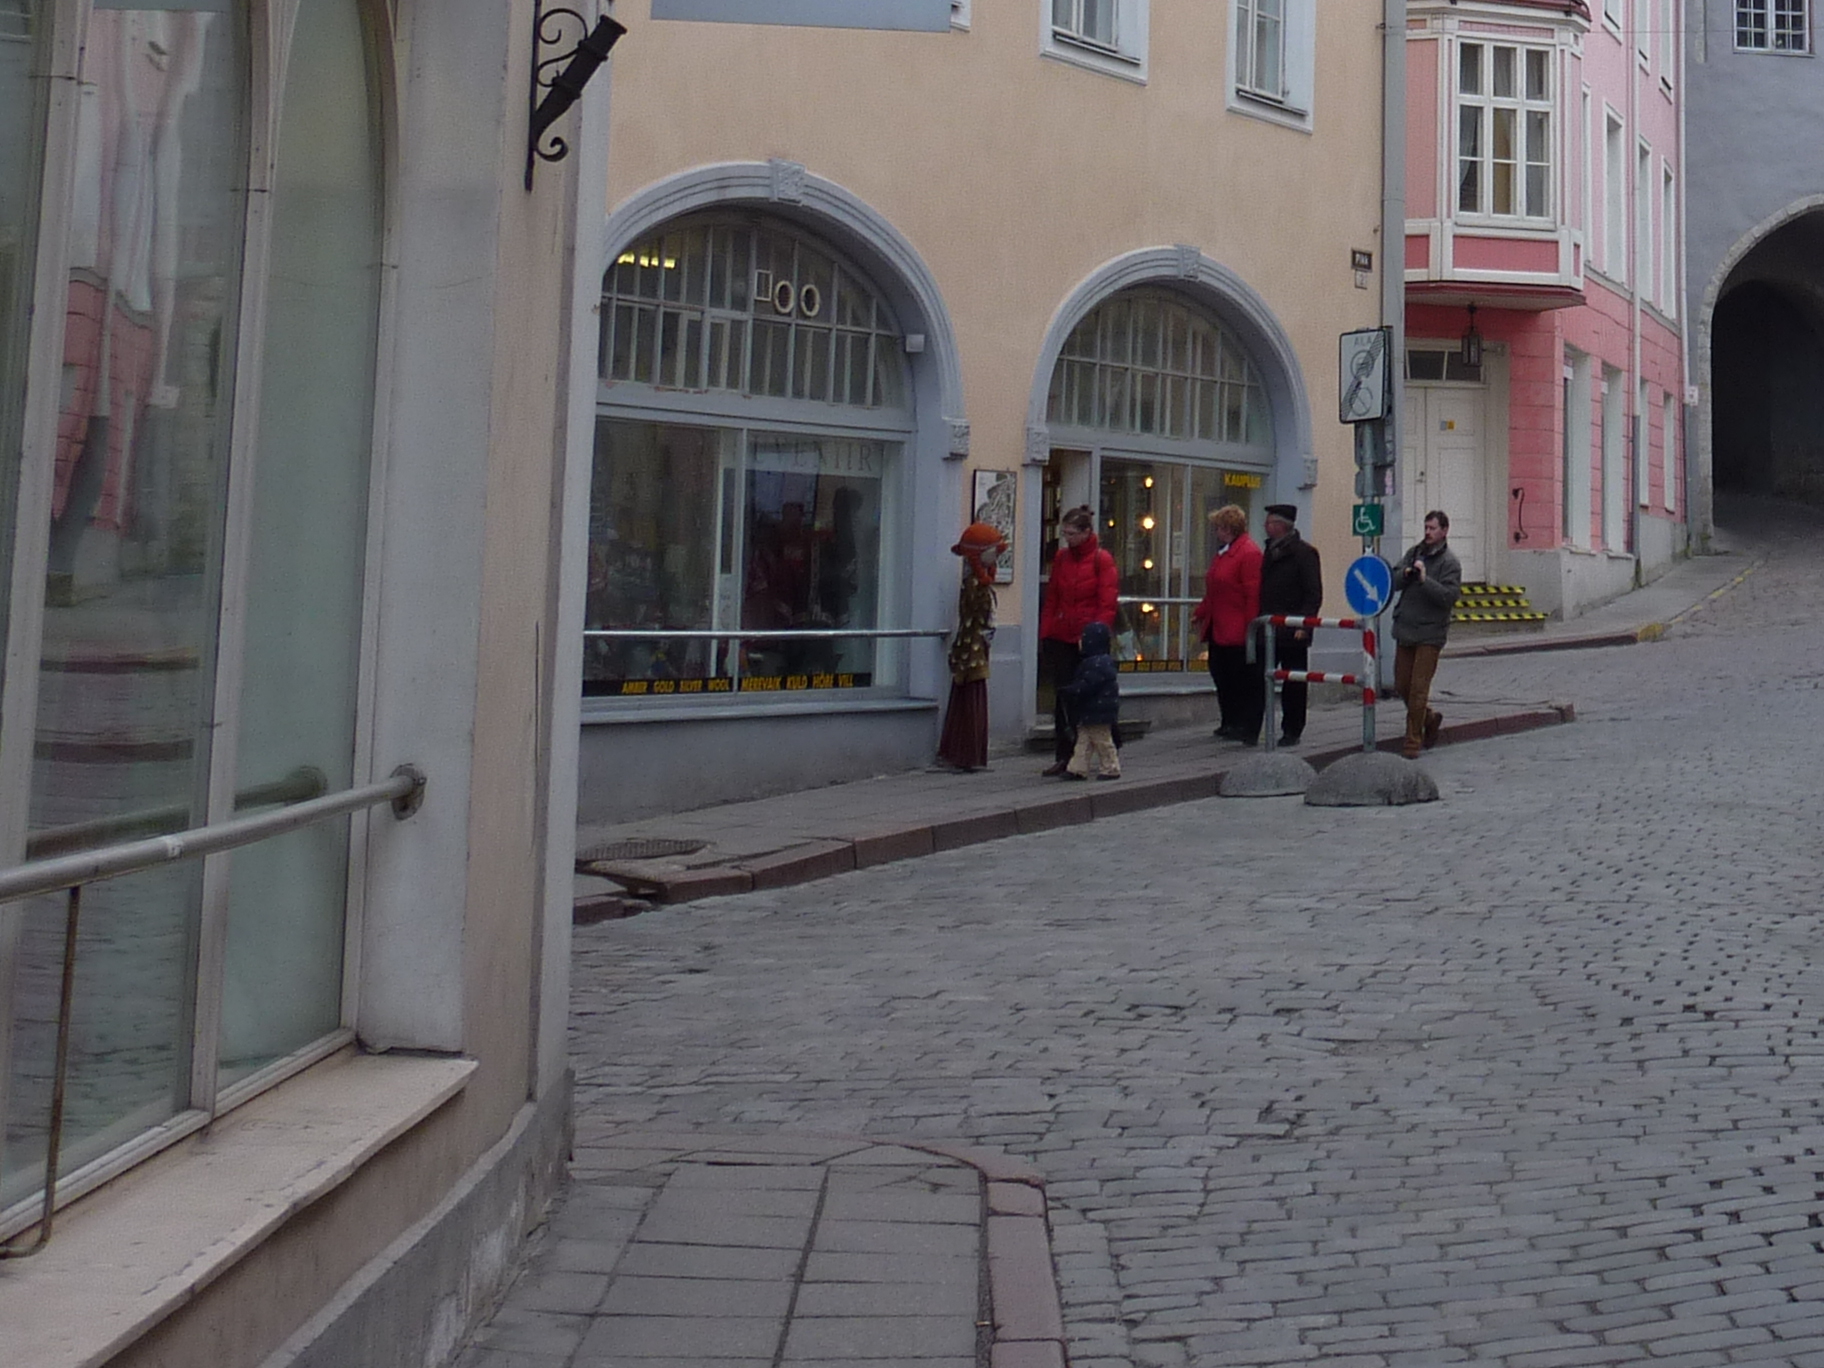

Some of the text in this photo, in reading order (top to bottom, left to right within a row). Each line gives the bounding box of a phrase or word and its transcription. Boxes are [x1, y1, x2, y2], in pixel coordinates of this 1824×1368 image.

[653, 680, 675, 693] GOLD
[707, 678, 730, 691] WOOL
[786, 674, 808, 690] KULD
[838, 674, 854, 688] VILL
